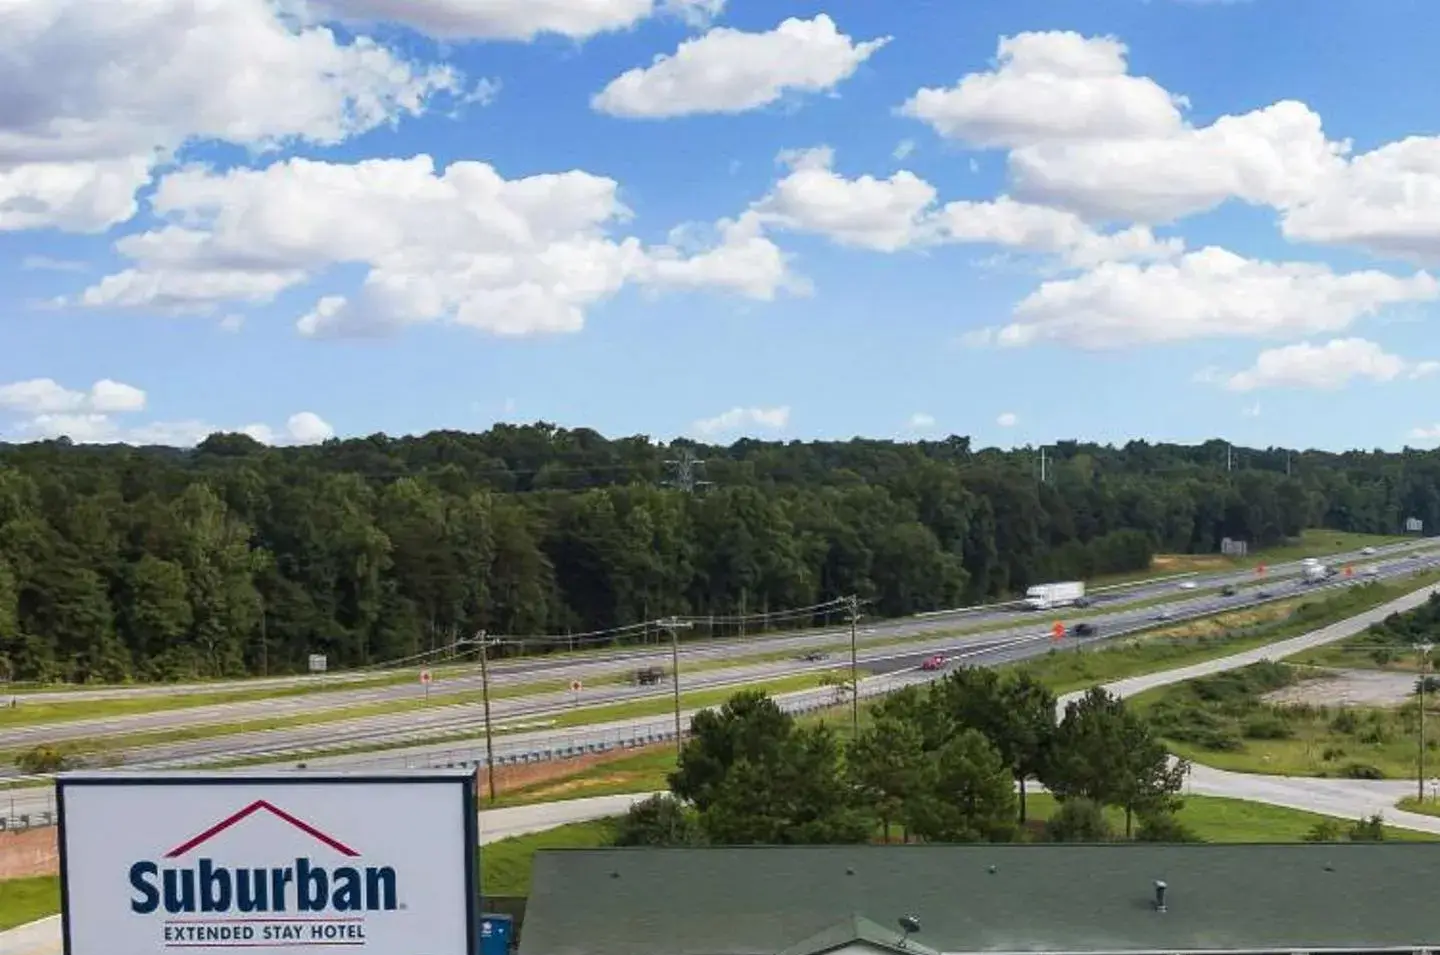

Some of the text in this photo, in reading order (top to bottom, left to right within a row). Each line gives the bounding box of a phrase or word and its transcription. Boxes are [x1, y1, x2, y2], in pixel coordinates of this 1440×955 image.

[129, 858, 397, 914] Suburban
[164, 924, 365, 940] EXTENDED STAY HOTEL
